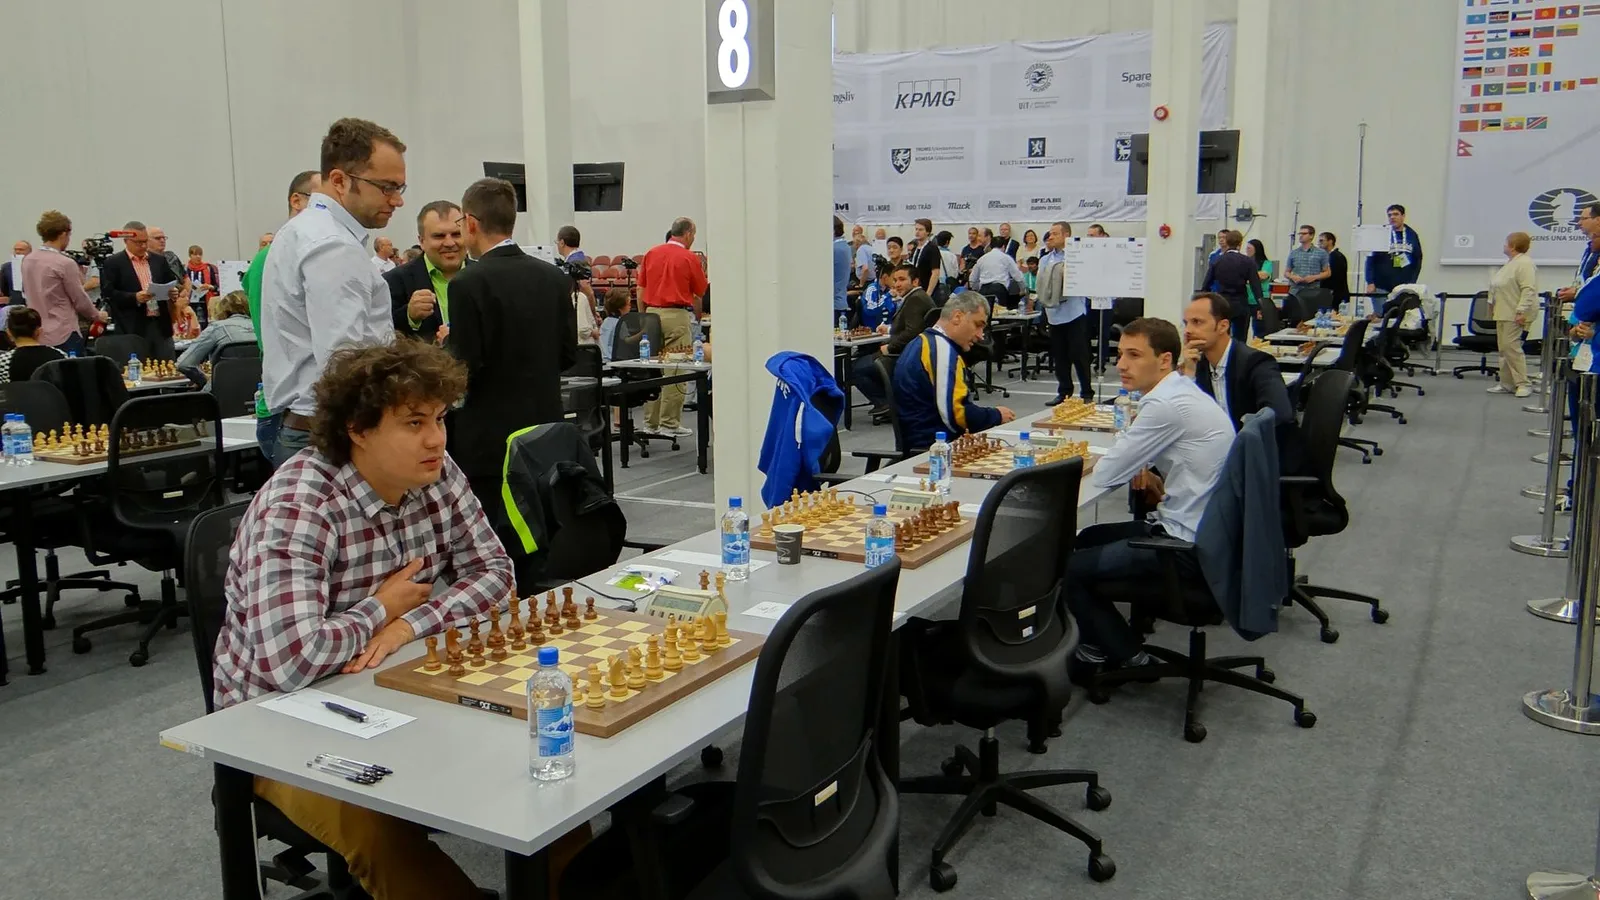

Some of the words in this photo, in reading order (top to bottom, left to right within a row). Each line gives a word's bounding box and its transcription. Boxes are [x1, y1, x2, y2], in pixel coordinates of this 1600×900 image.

[717, 0, 750, 88] 8
[1122, 72, 1151, 83] Spare
[895, 90, 956, 109] KPMG
[947, 202, 971, 210] Mack
